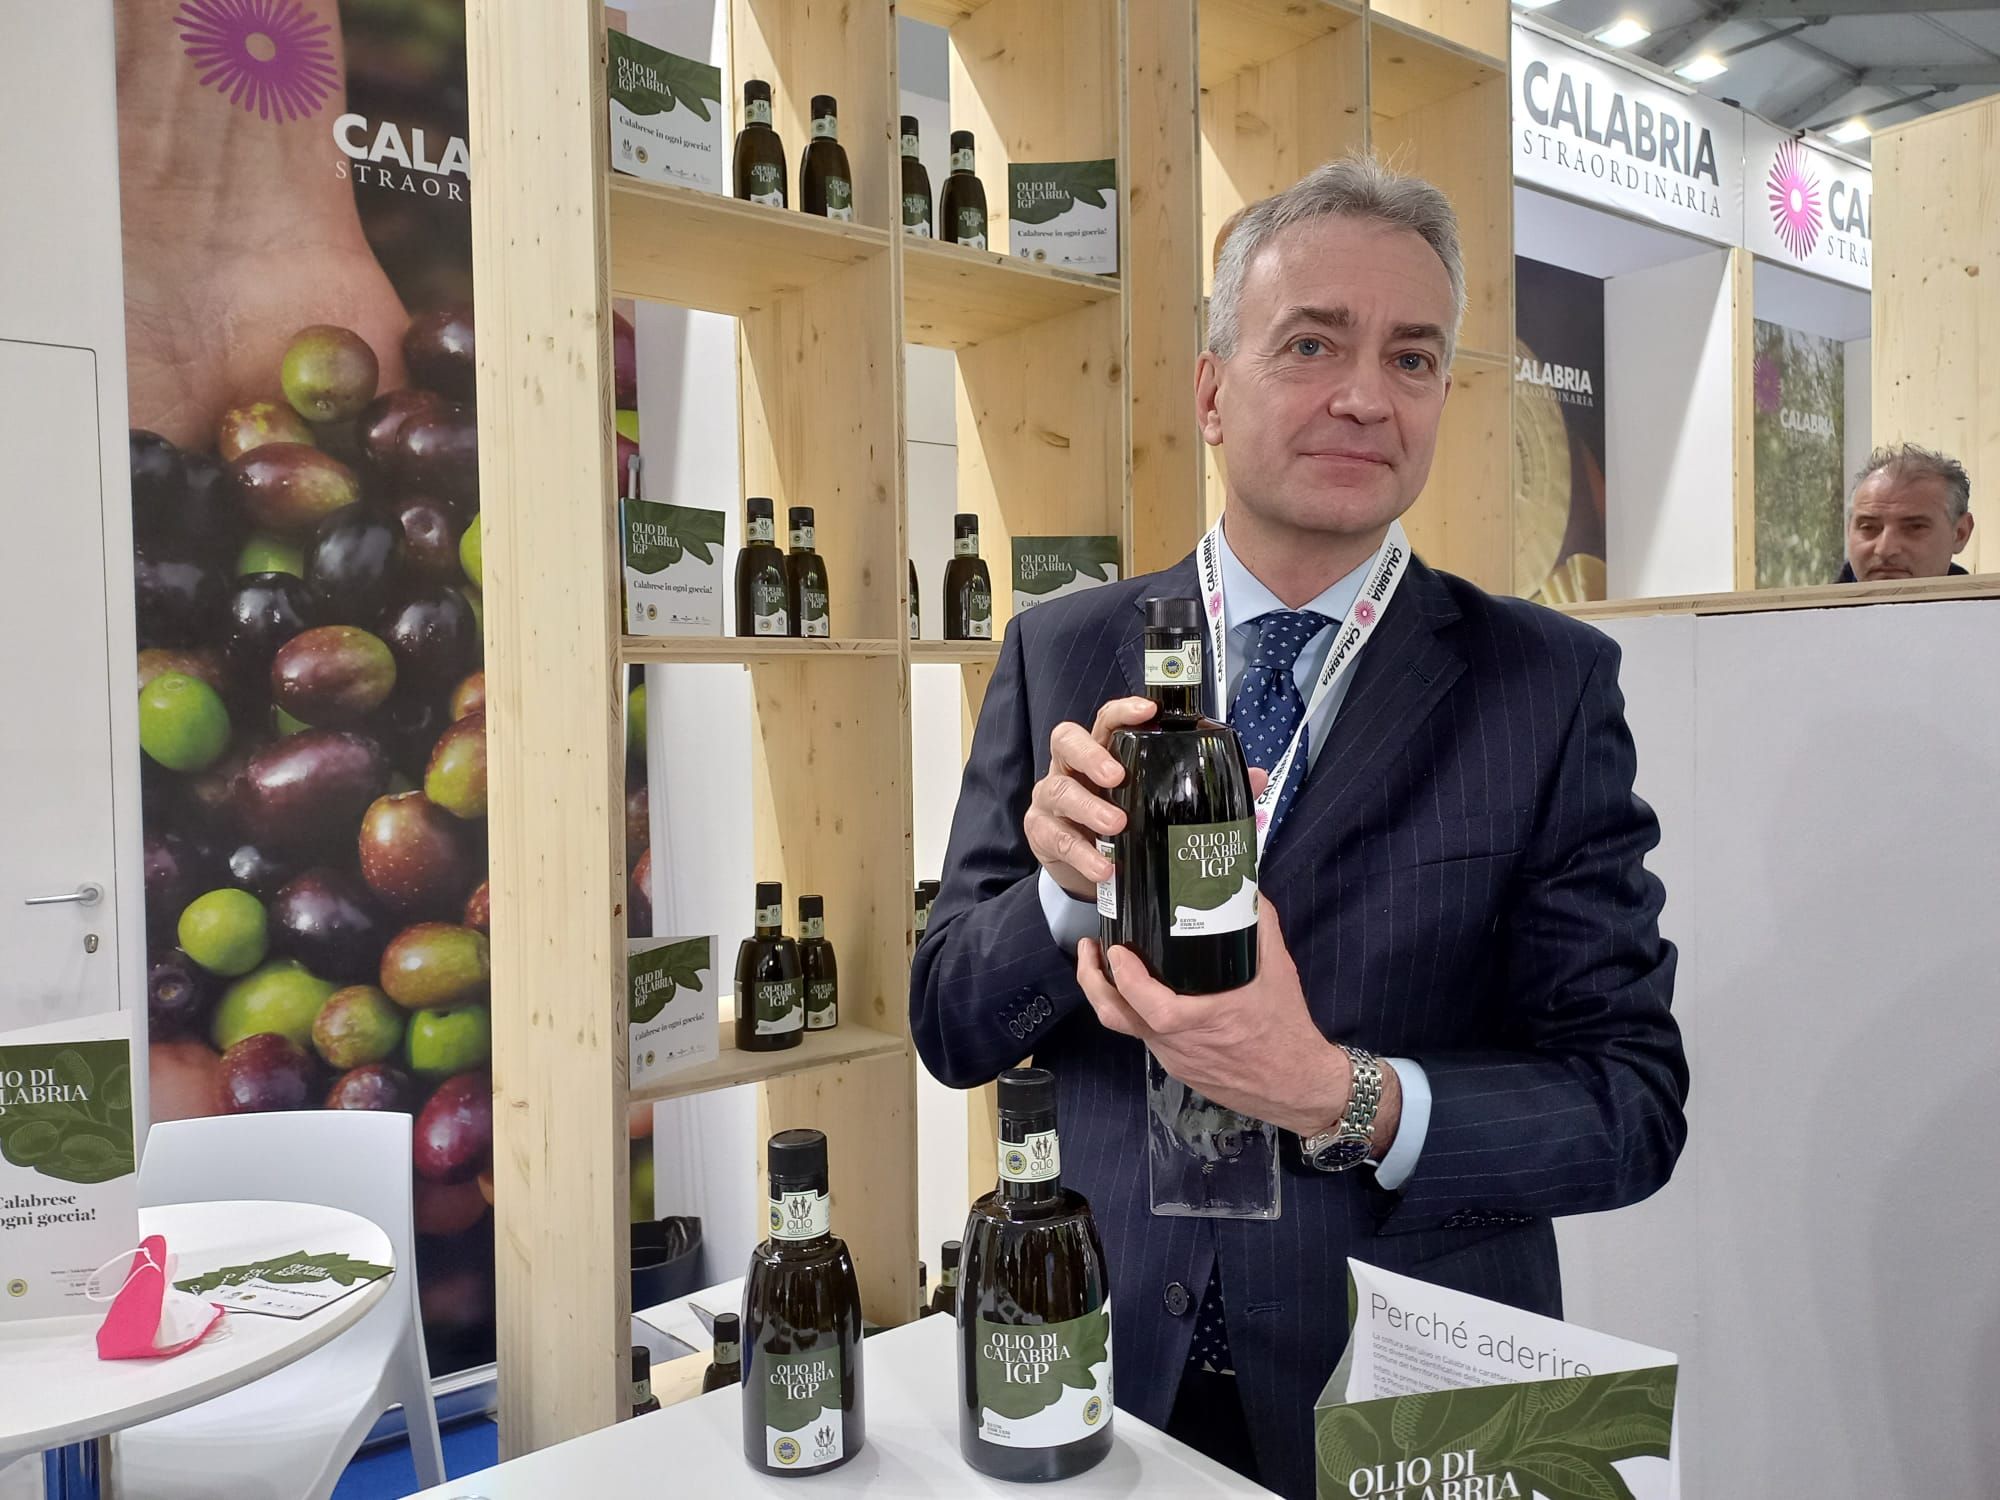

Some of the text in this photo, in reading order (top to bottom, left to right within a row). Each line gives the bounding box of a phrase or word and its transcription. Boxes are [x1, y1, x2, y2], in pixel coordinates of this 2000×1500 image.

[618, 56, 657, 81] OLIO DI
[618, 67, 671, 97] CALABRIA
[619, 115, 654, 135] Calabrese
[655, 128, 664, 140] in
[665, 134, 682, 145] ogni
[1523, 60, 1720, 187] CALABRIA
[335, 160, 464, 202] STRAOR
[1523, 129, 1721, 218] STRAORDINARIA
[1017, 181, 1057, 191] OLIO DI
[1017, 190, 1071, 200] CALABRIA
[1017, 199, 1036, 209] IGP
[1829, 180, 1872, 240] CA
[632, 522, 667, 536] OLIO DI
[632, 532, 680, 548] CALABRIA
[632, 543, 648, 554] IGP
[1021, 554, 1059, 563] OLIO DI
[1021, 562, 1073, 571] CALABRIA
[1203, 533, 1216, 592] CALABRIA
[1021, 571, 1038, 580] IGP
[1371, 547, 1402, 602] CALABRIA
[633, 580, 664, 590] Calabrese
[665, 582, 671, 591] in
[673, 583, 687, 593] ogni
[1322, 627, 1361, 687] CALABRIA
[1187, 829, 1241, 848] OLIO DI
[1177, 840, 1248, 861] CALABRIA
[1200, 856, 1235, 879] IGP
[634, 976, 674, 998] CALABRIA
[635, 968, 663, 987] OLIO DI
[635, 995, 648, 1008] IGP
[770, 996, 789, 1007] IGP
[29, 1068, 56, 1087] DI
[1031, 1159, 1054, 1171] OLIO
[37, 1208, 96, 1228] goccia!
[787, 1219, 813, 1230] OLIO
[991, 1332, 1058, 1349] OLIO DI
[1371, 1292, 1592, 1378] Perché aderire
[983, 1344, 1071, 1363] CALABRIA
[770, 1369, 835, 1385] CALABRIA
[777, 1360, 825, 1376] OLIO DI
[1004, 1363, 1050, 1384] IGP
[786, 1382, 820, 1400] IGP
[813, 1445, 837, 1458] OLIO
[1349, 1449, 1477, 1500] OLIO DI
